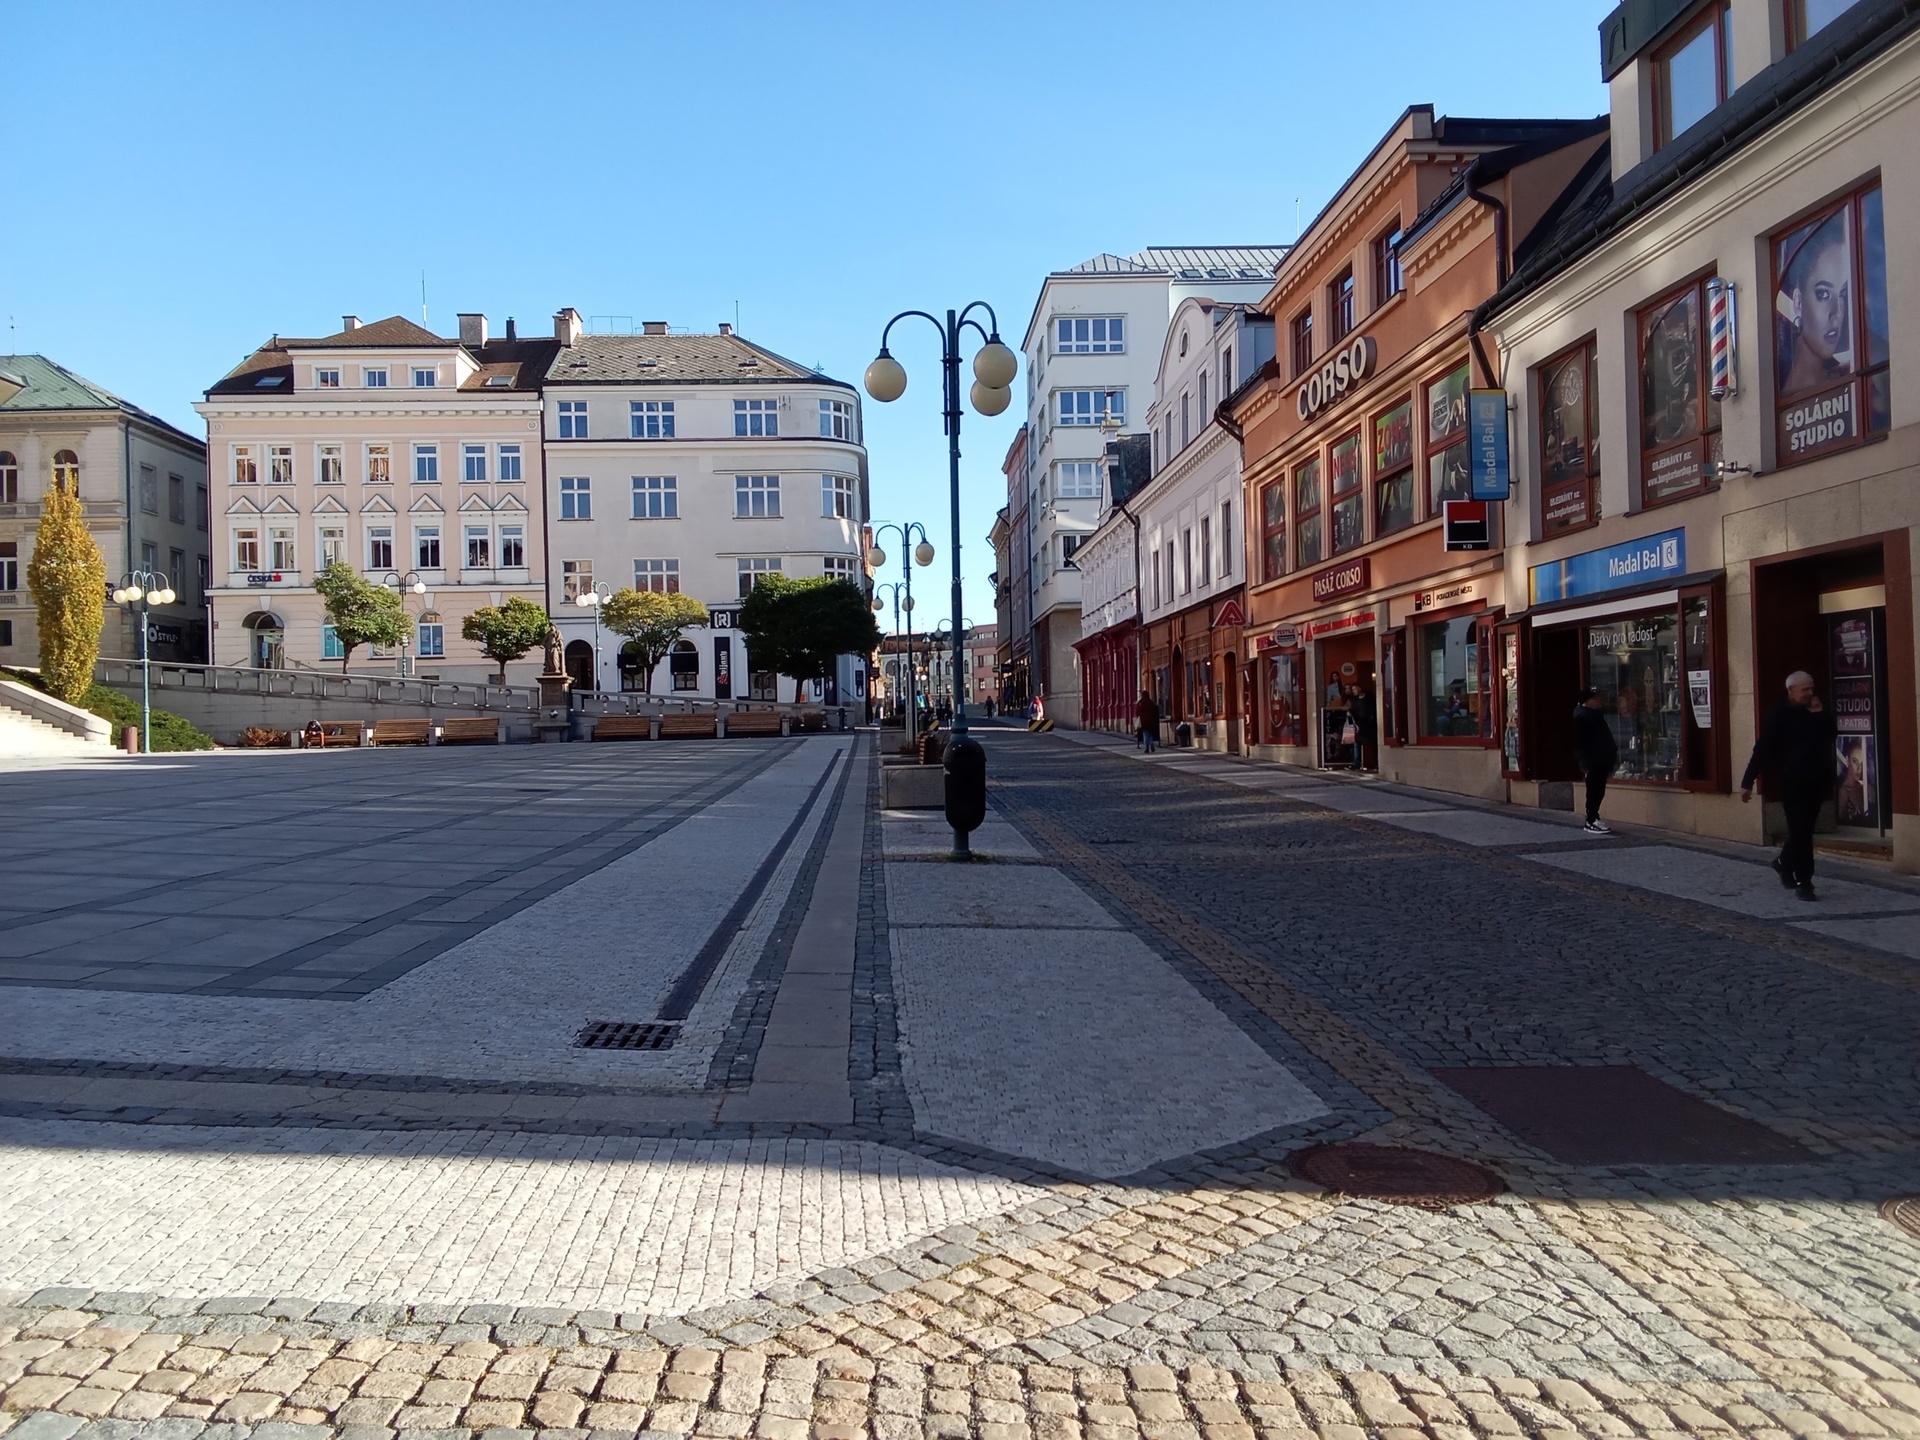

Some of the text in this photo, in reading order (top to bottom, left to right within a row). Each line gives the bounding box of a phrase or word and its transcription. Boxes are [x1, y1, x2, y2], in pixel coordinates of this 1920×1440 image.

[1297, 336, 1368, 421] CORSO
[1785, 387, 1849, 431] SOLÁRNÍ
[1790, 418, 1845, 451] STUDIO
[1481, 422, 1497, 488] Madal Bal
[1609, 546, 1660, 578] Madal Bal
[247, 574, 272, 583] ČESKÁ
[1314, 566, 1361, 598] PASÁŽ CORSO
[1422, 594, 1432, 607] KB
[1612, 632, 1626, 645] pro
[1836, 698, 1871, 712] STUDIO
[1839, 718, 1869, 728] 1.PATRO
